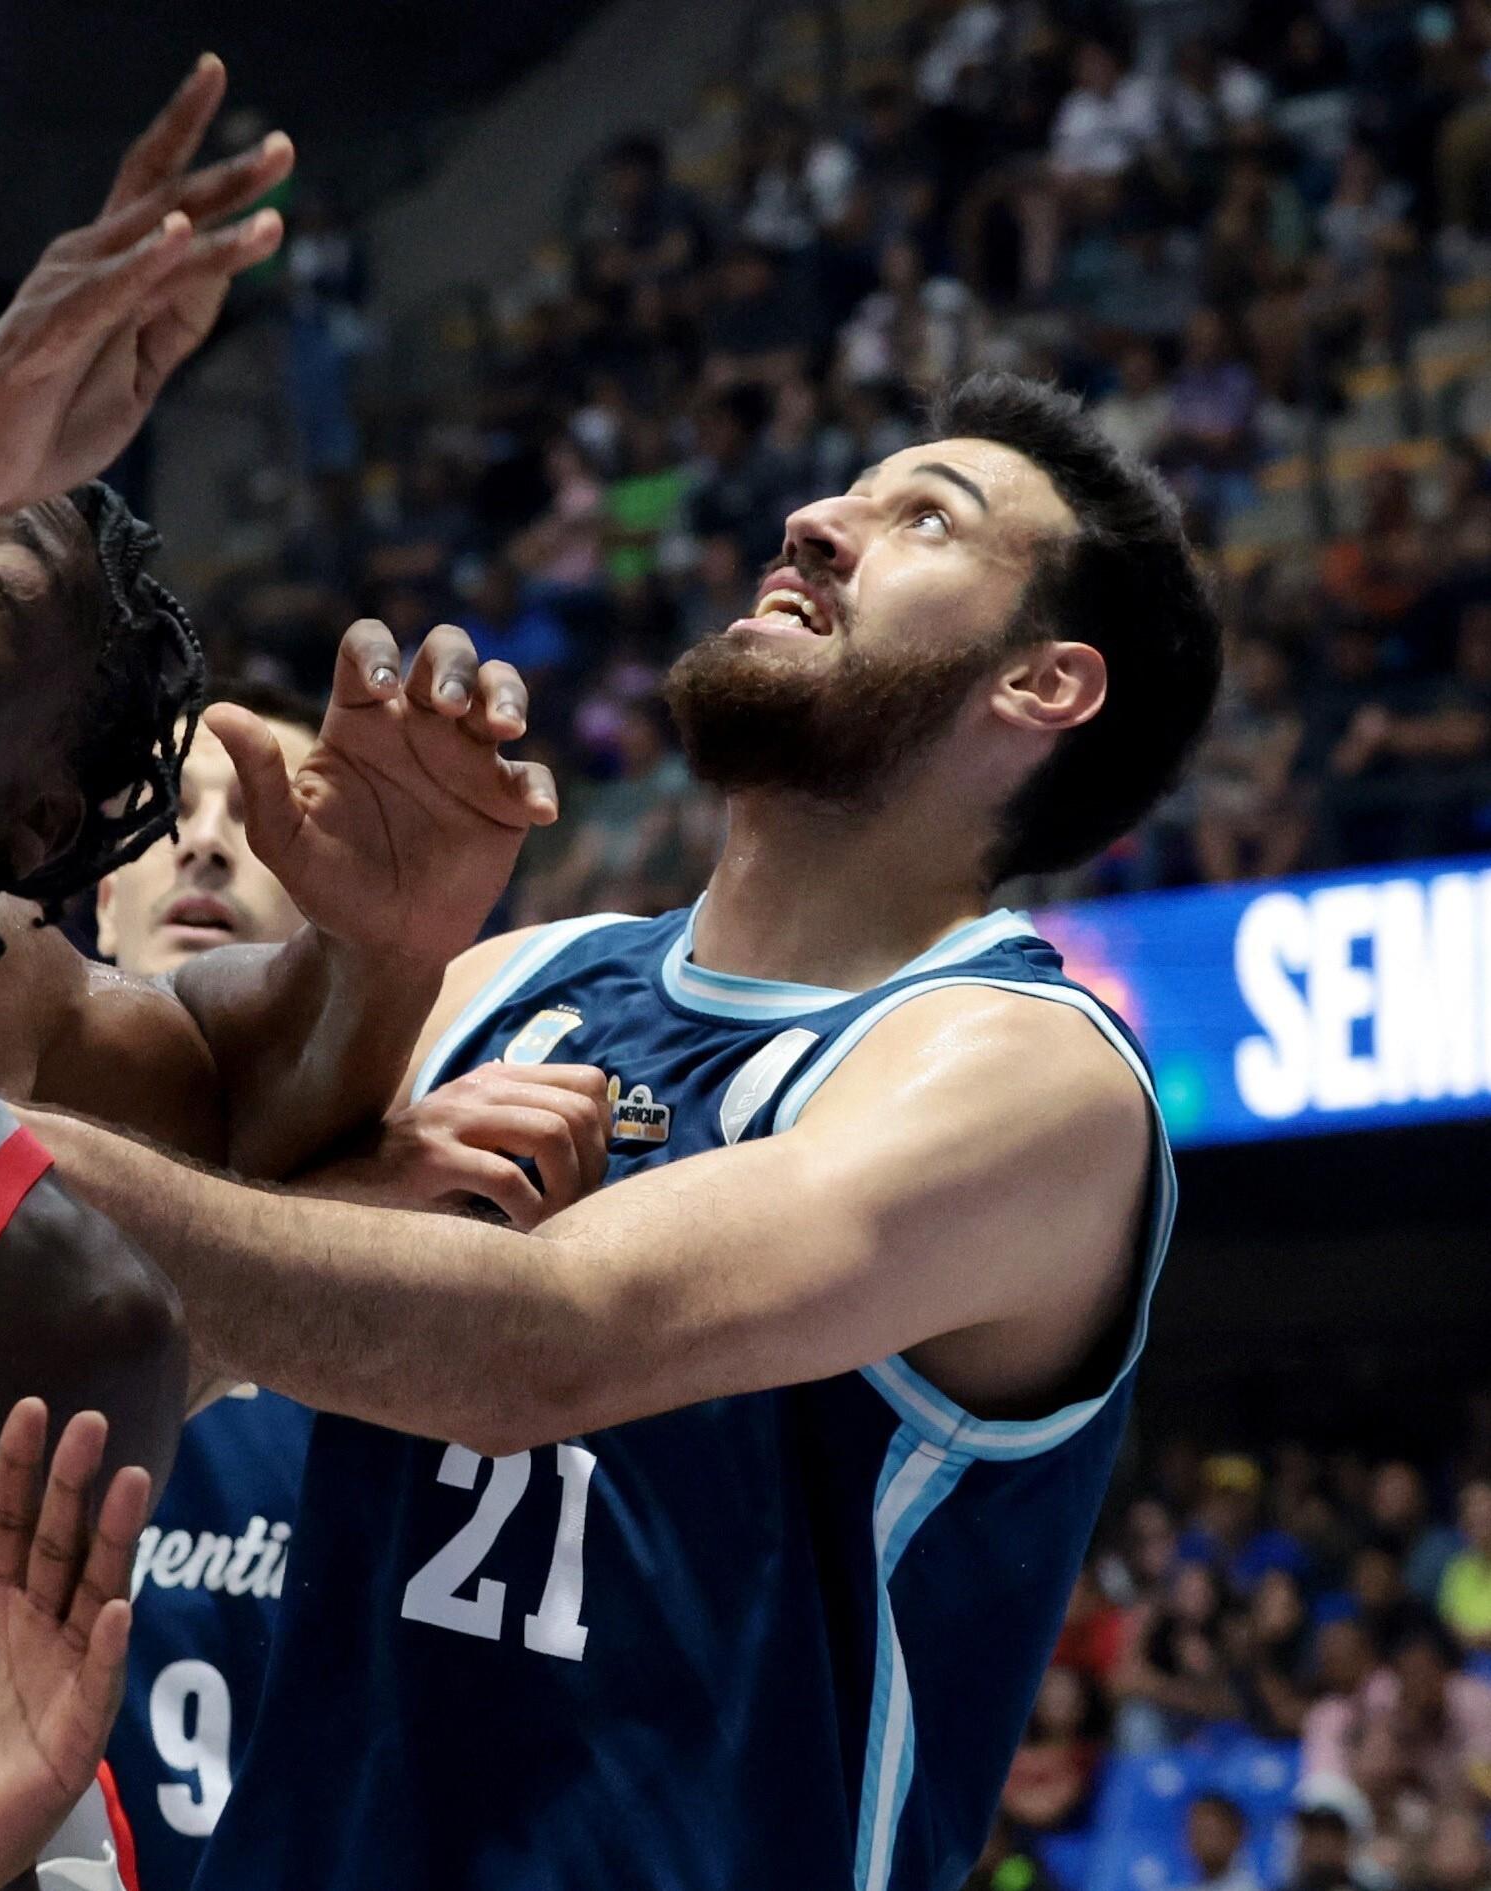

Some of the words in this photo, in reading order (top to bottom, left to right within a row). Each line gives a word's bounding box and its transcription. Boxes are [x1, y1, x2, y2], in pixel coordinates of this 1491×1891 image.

[1236, 870, 1491, 1118] SEM
[401, 1443, 597, 1662] 21
[149, 1659, 233, 1837] 9
